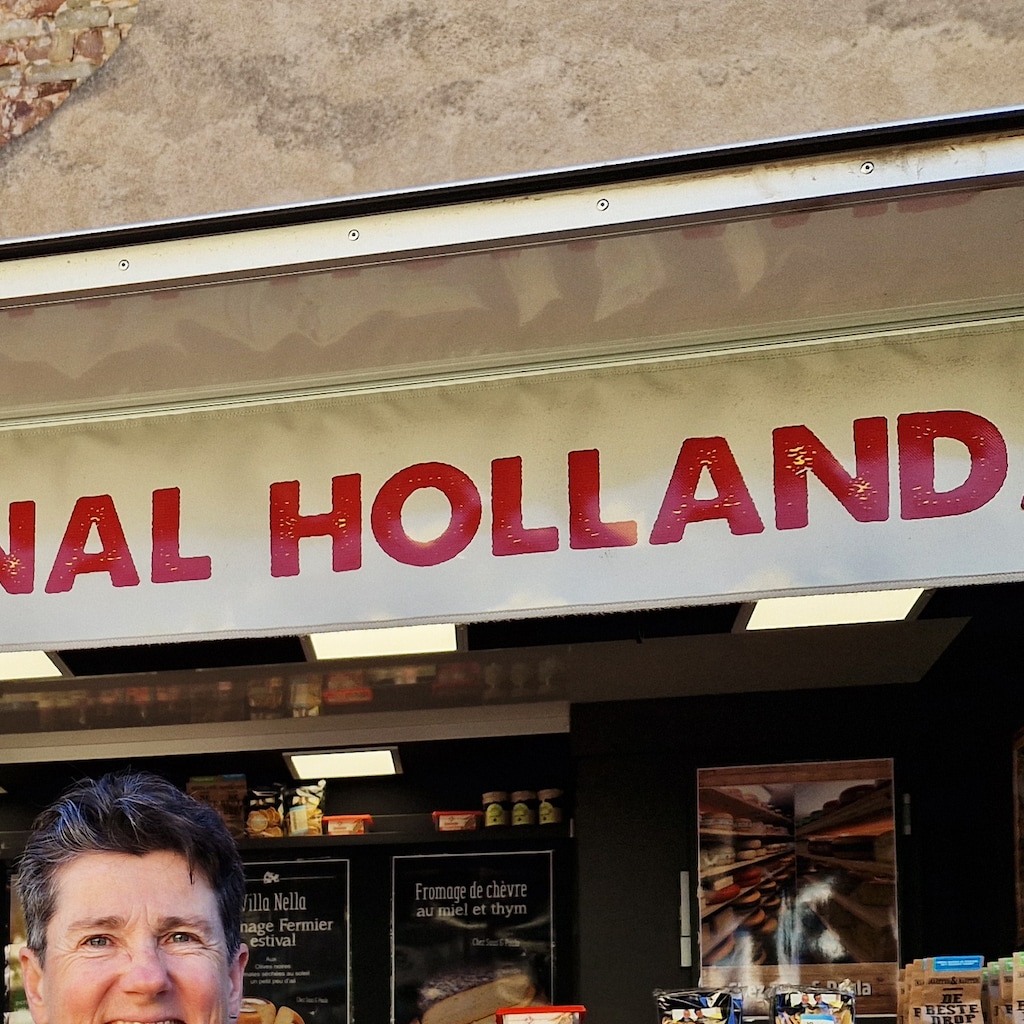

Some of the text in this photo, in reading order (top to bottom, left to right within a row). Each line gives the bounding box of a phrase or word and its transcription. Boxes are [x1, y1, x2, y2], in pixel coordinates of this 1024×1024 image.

[269, 409, 1024, 577] HOLLAND
[415, 880, 527, 903] Fromage de chèvre
[274, 892, 307, 911] Nella
[416, 901, 527, 919] au miel et thym
[279, 918, 334, 932] Fermier
[250, 933, 297, 947] estival
[941, 993, 964, 1004] DE
[925, 1004, 980, 1016] BESTE
